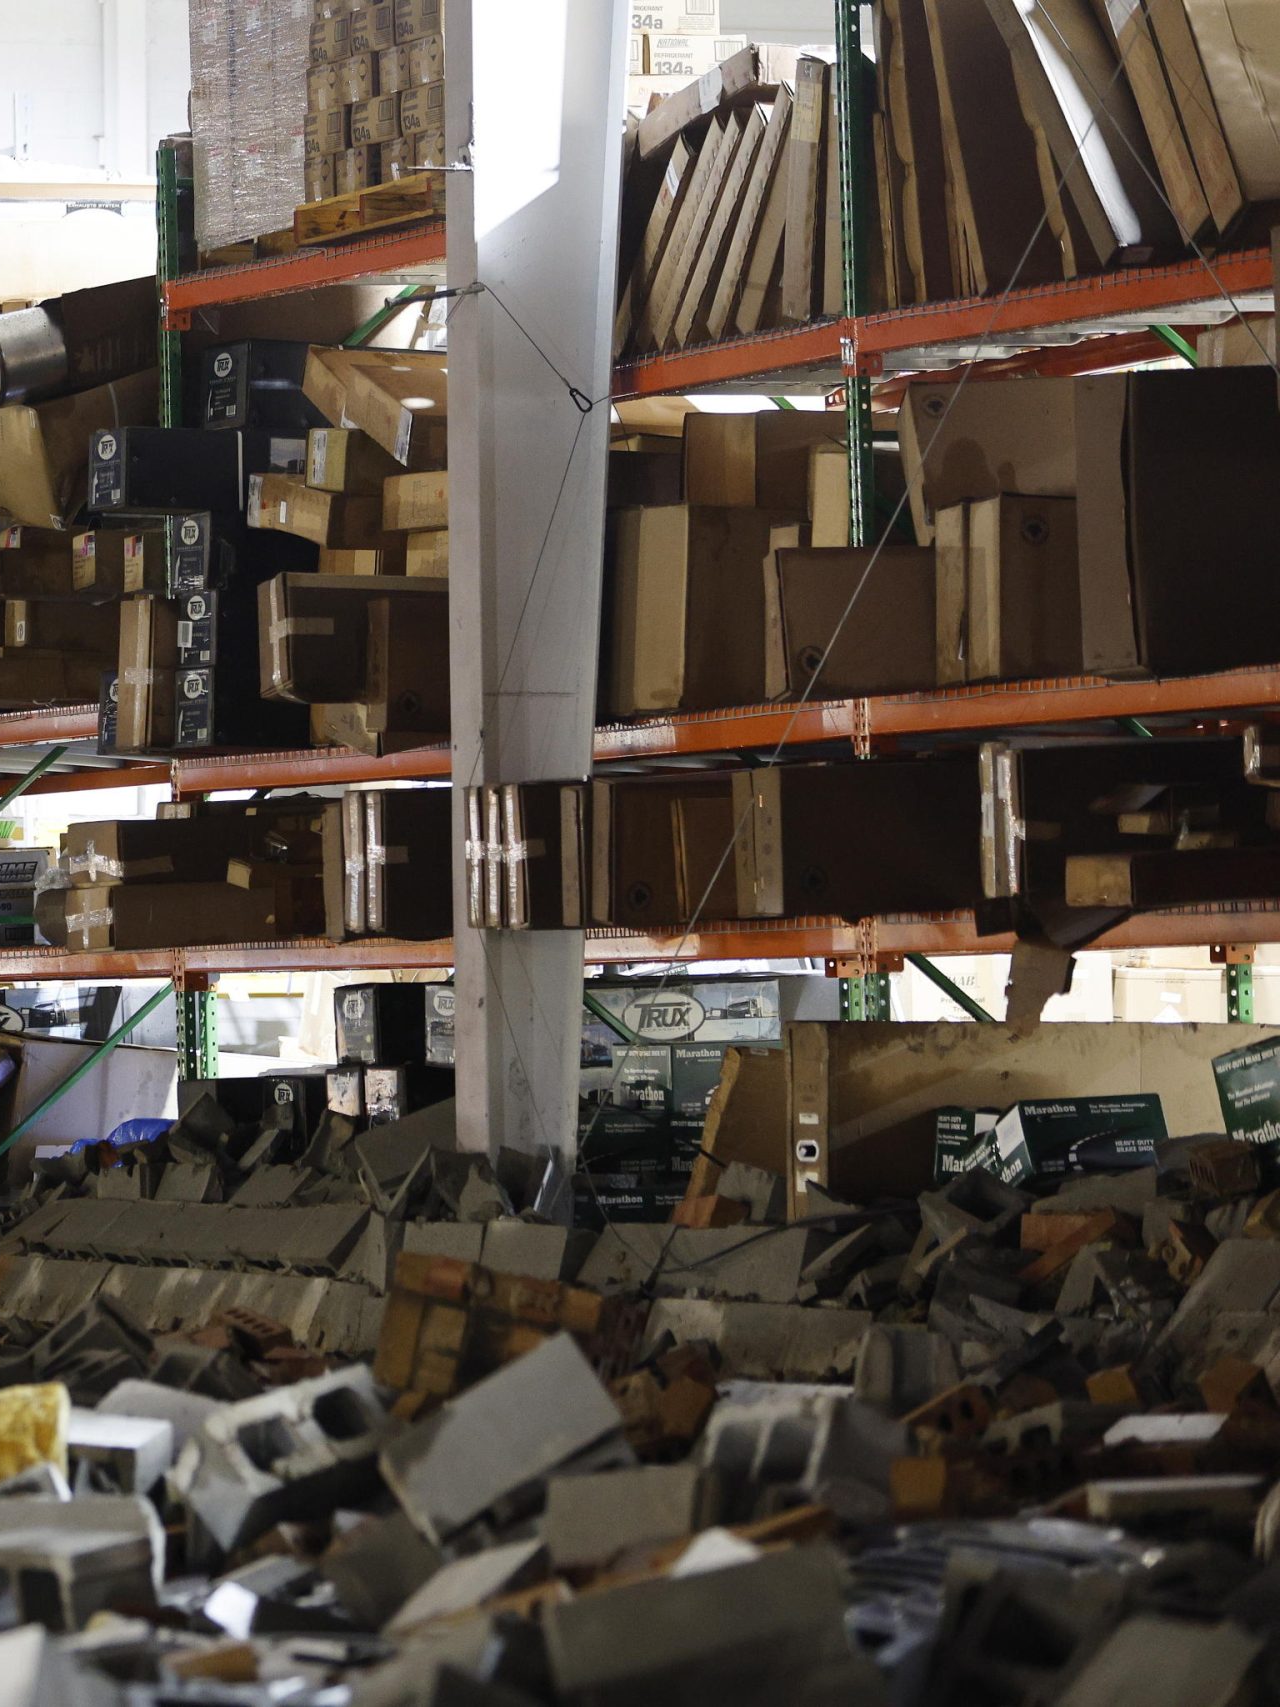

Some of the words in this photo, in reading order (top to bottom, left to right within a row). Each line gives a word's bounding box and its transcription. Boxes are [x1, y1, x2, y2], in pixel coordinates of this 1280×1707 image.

[632, 14, 663, 29] 34a
[655, 62, 694, 75] 134a
[635, 1002, 693, 1029] TRUX
[676, 1048, 721, 1059] Marathon
[1024, 1103, 1077, 1116] Marathon
[598, 1195, 643, 1205] Marathon
